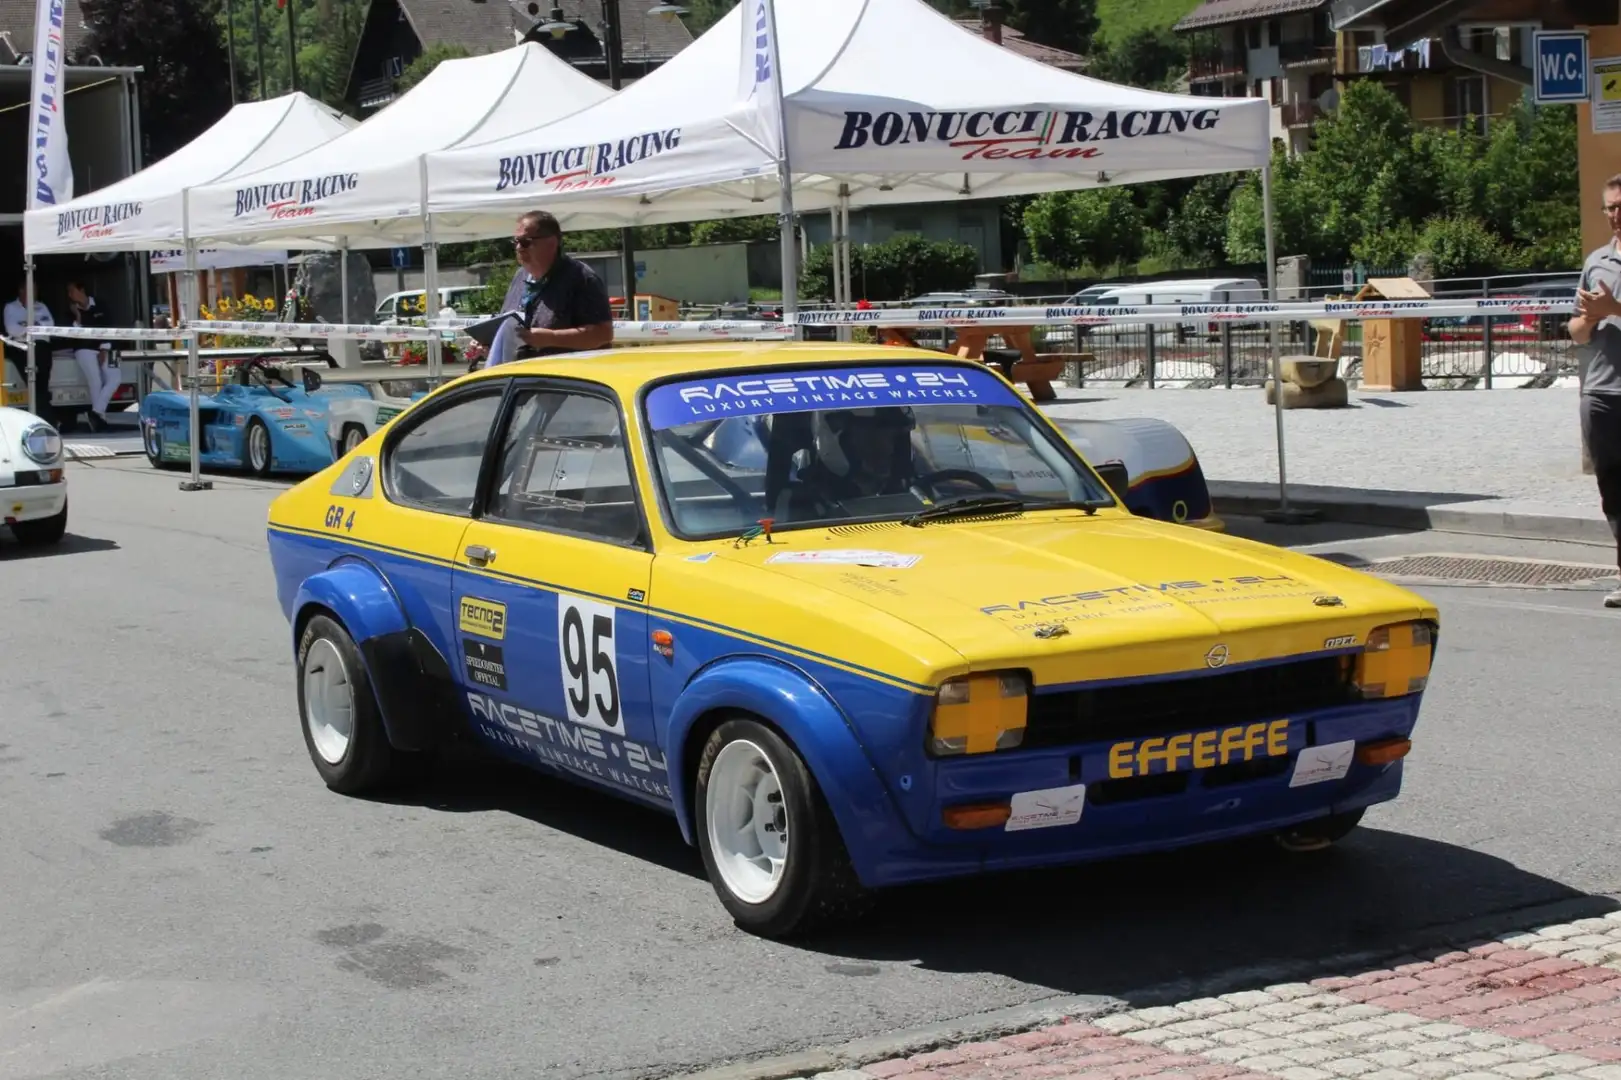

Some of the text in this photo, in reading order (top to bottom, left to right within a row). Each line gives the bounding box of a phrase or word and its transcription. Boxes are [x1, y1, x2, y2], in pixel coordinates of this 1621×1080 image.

[1541, 52, 1582, 81] W.C.
[834, 108, 1220, 149] BONUCCI RACING
[496, 128, 681, 191] BONUCCI RACING
[949, 137, 1104, 160] Team
[234, 172, 358, 217] BONUCCI RACING
[266, 200, 316, 219] Team
[57, 201, 143, 232] BONUCCI RACING
[80, 223, 114, 239] Team
[843, 312, 881, 322] RACING
[679, 372, 968, 403] RACETIME 24
[691, 389, 978, 415] LUXURY VINTAGE WATCHES
[325, 505, 356, 532] GR 4
[980, 580, 1208, 615] RACETIME
[563, 606, 619, 728] 95
[467, 692, 607, 759] RACETIME
[481, 724, 532, 752] LUXURY
[537, 744, 604, 776] VINTAGE
[1109, 719, 1289, 779] EFFEFFE
